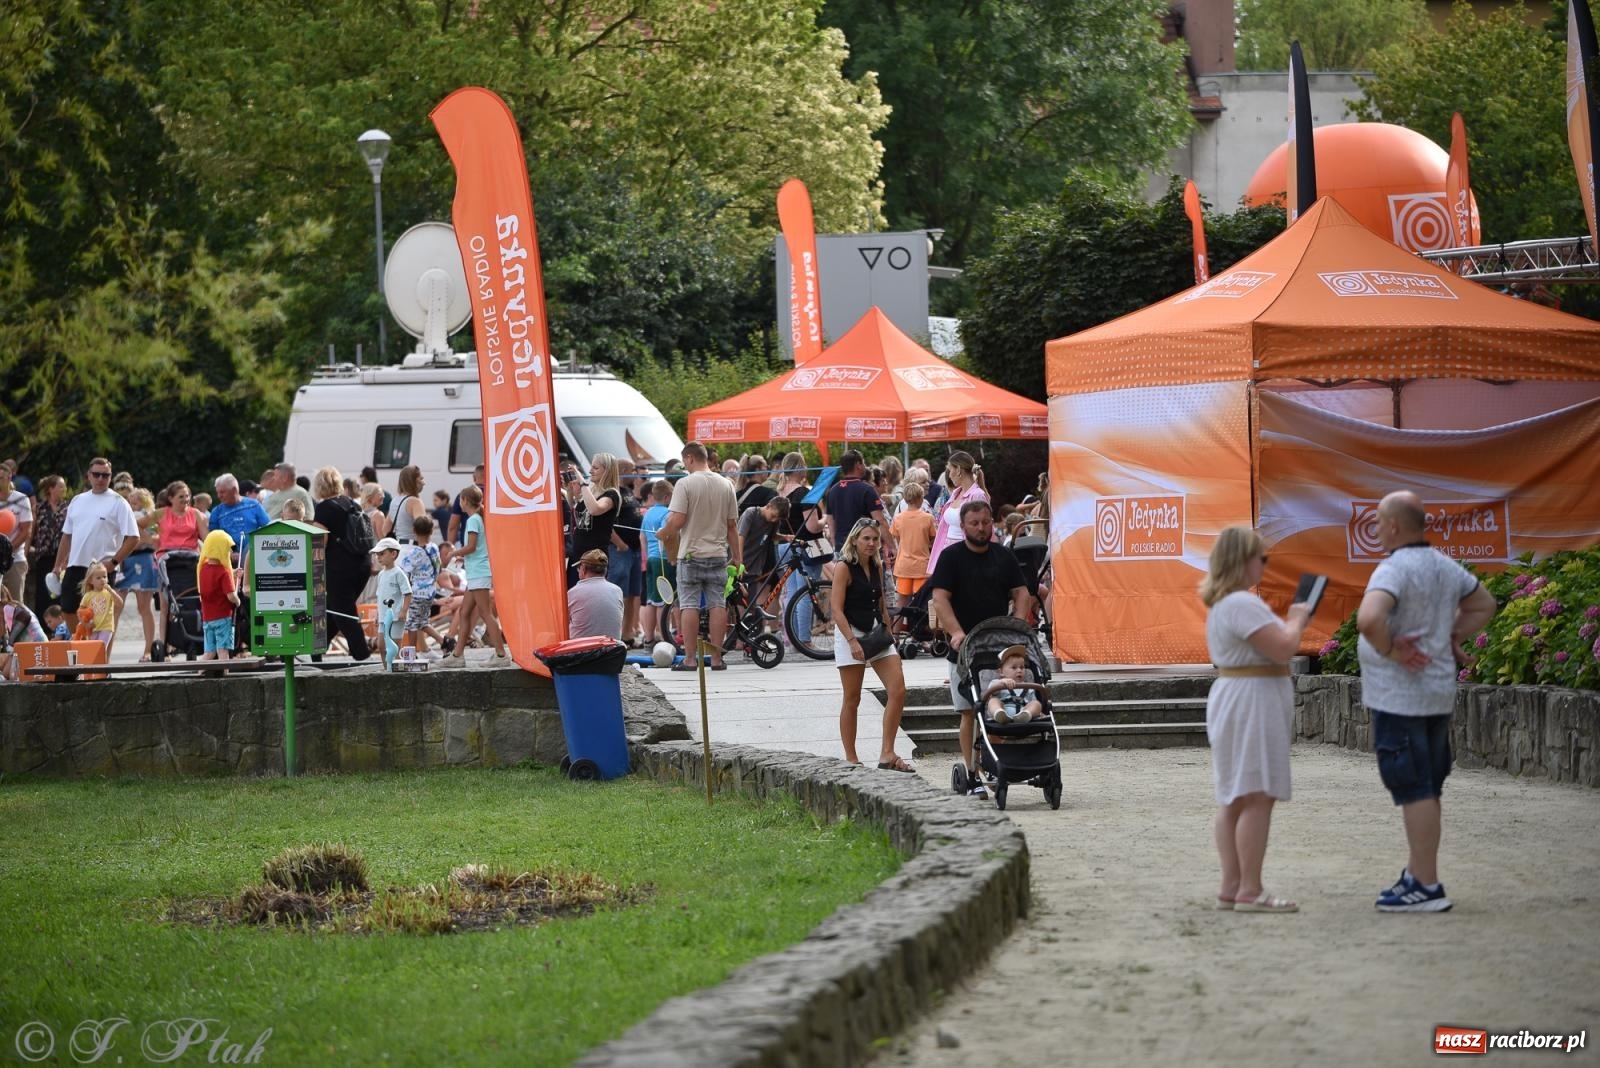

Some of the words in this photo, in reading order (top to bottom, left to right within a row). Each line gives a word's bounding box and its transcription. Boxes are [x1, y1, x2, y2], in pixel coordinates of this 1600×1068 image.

[1371, 272, 1441, 289] Jedynka
[822, 367, 872, 381] Jedynka
[1128, 501, 1179, 538] Jedynka
[1423, 508, 1499, 541] edynka
[1130, 543, 1155, 553] POLSKIE
[1155, 542, 1176, 553] RADIO
[1459, 545, 1495, 556] RADIO
